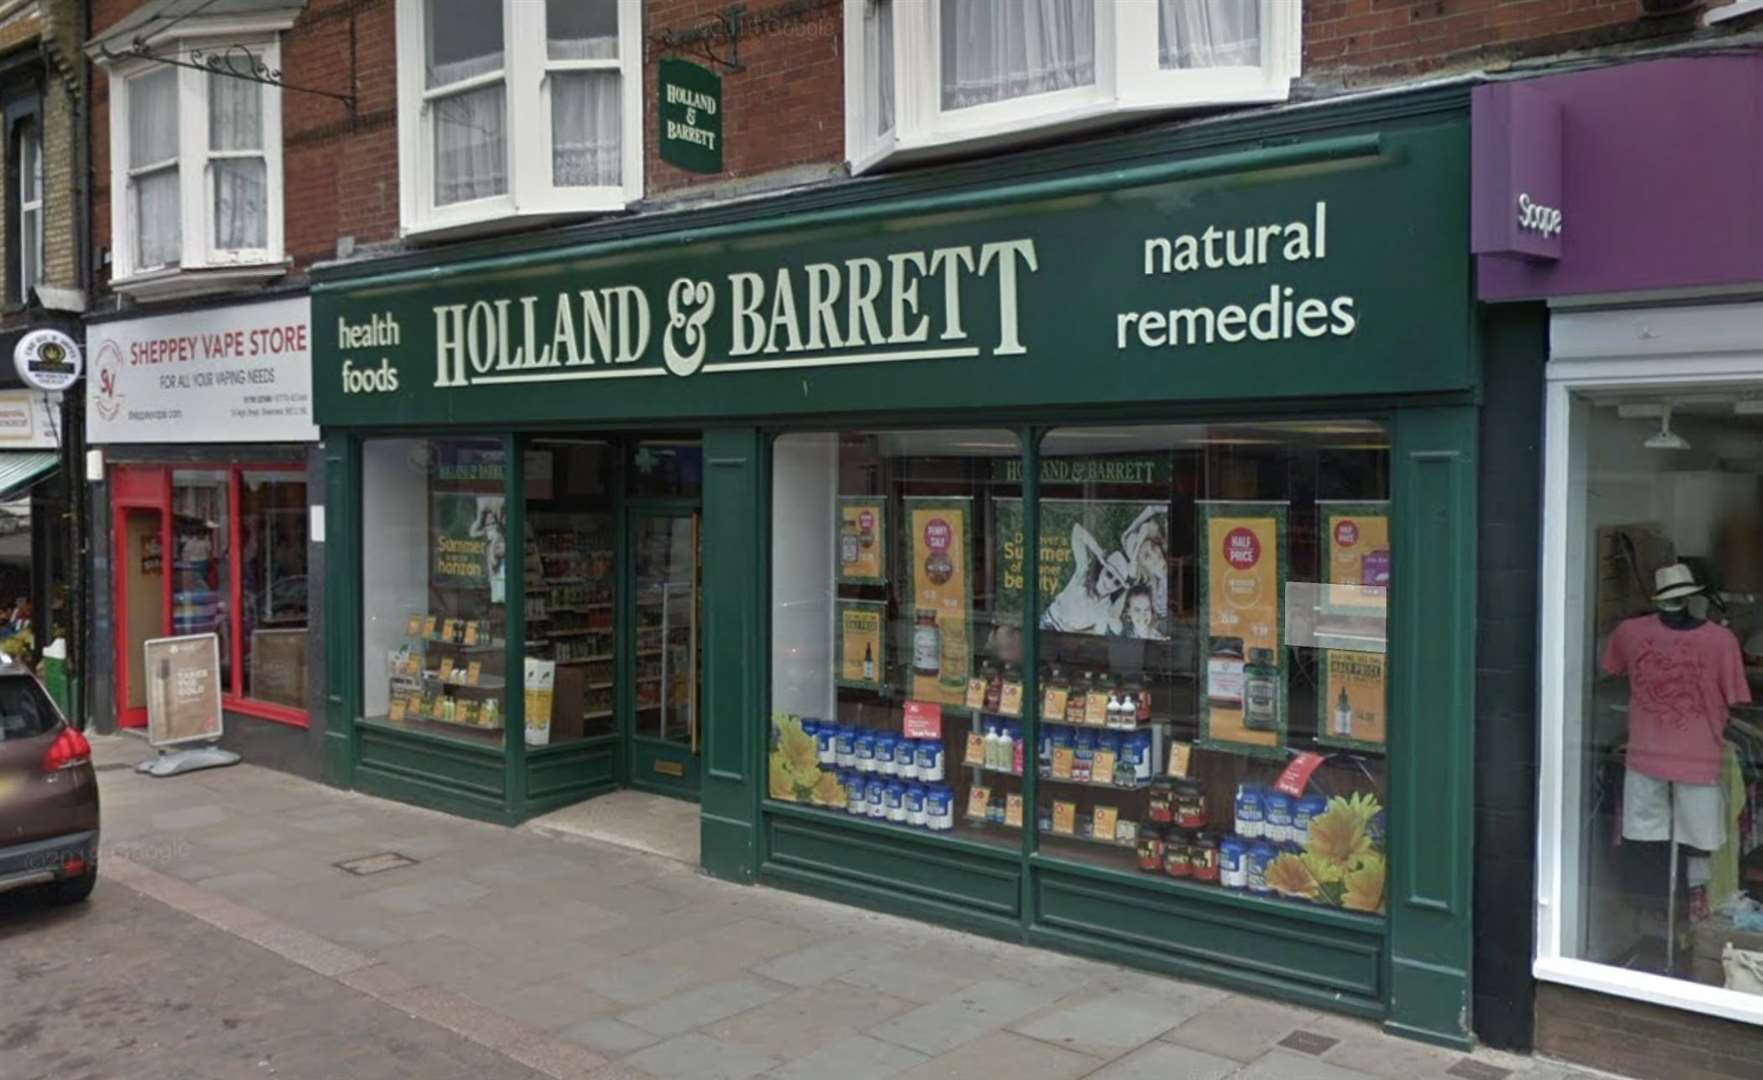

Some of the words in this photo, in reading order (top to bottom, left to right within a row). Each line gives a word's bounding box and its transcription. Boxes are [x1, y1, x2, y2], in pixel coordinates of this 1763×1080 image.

[666, 84, 716, 115] HOLLAND
[686, 107, 697, 126] &
[667, 120, 716, 150] BARRETT
[1518, 193, 1562, 239] Scope
[1144, 201, 1326, 274] natural
[432, 285, 651, 387] HOLLAND
[663, 277, 716, 376] &
[727, 239, 1039, 355] BARRETT
[1117, 284, 1356, 349] remedies
[130, 336, 198, 366] SHEPPEY
[201, 331, 245, 359] VAPE
[249, 324, 307, 356] STORE
[338, 311, 400, 349] health
[159, 373, 177, 389] FOR
[177, 372, 190, 388] ALL
[193, 371, 213, 388] YOUR
[215, 369, 246, 386] VAPING
[247, 367, 275, 384] NEEDS
[341, 358, 399, 393] foods
[1088, 461, 1156, 483] BARRETT
[1004, 541, 1071, 562] Sumer
[1229, 550, 1254, 562] PRICE
[1232, 536, 1251, 548] HALF
[1004, 570, 1058, 596] bety
